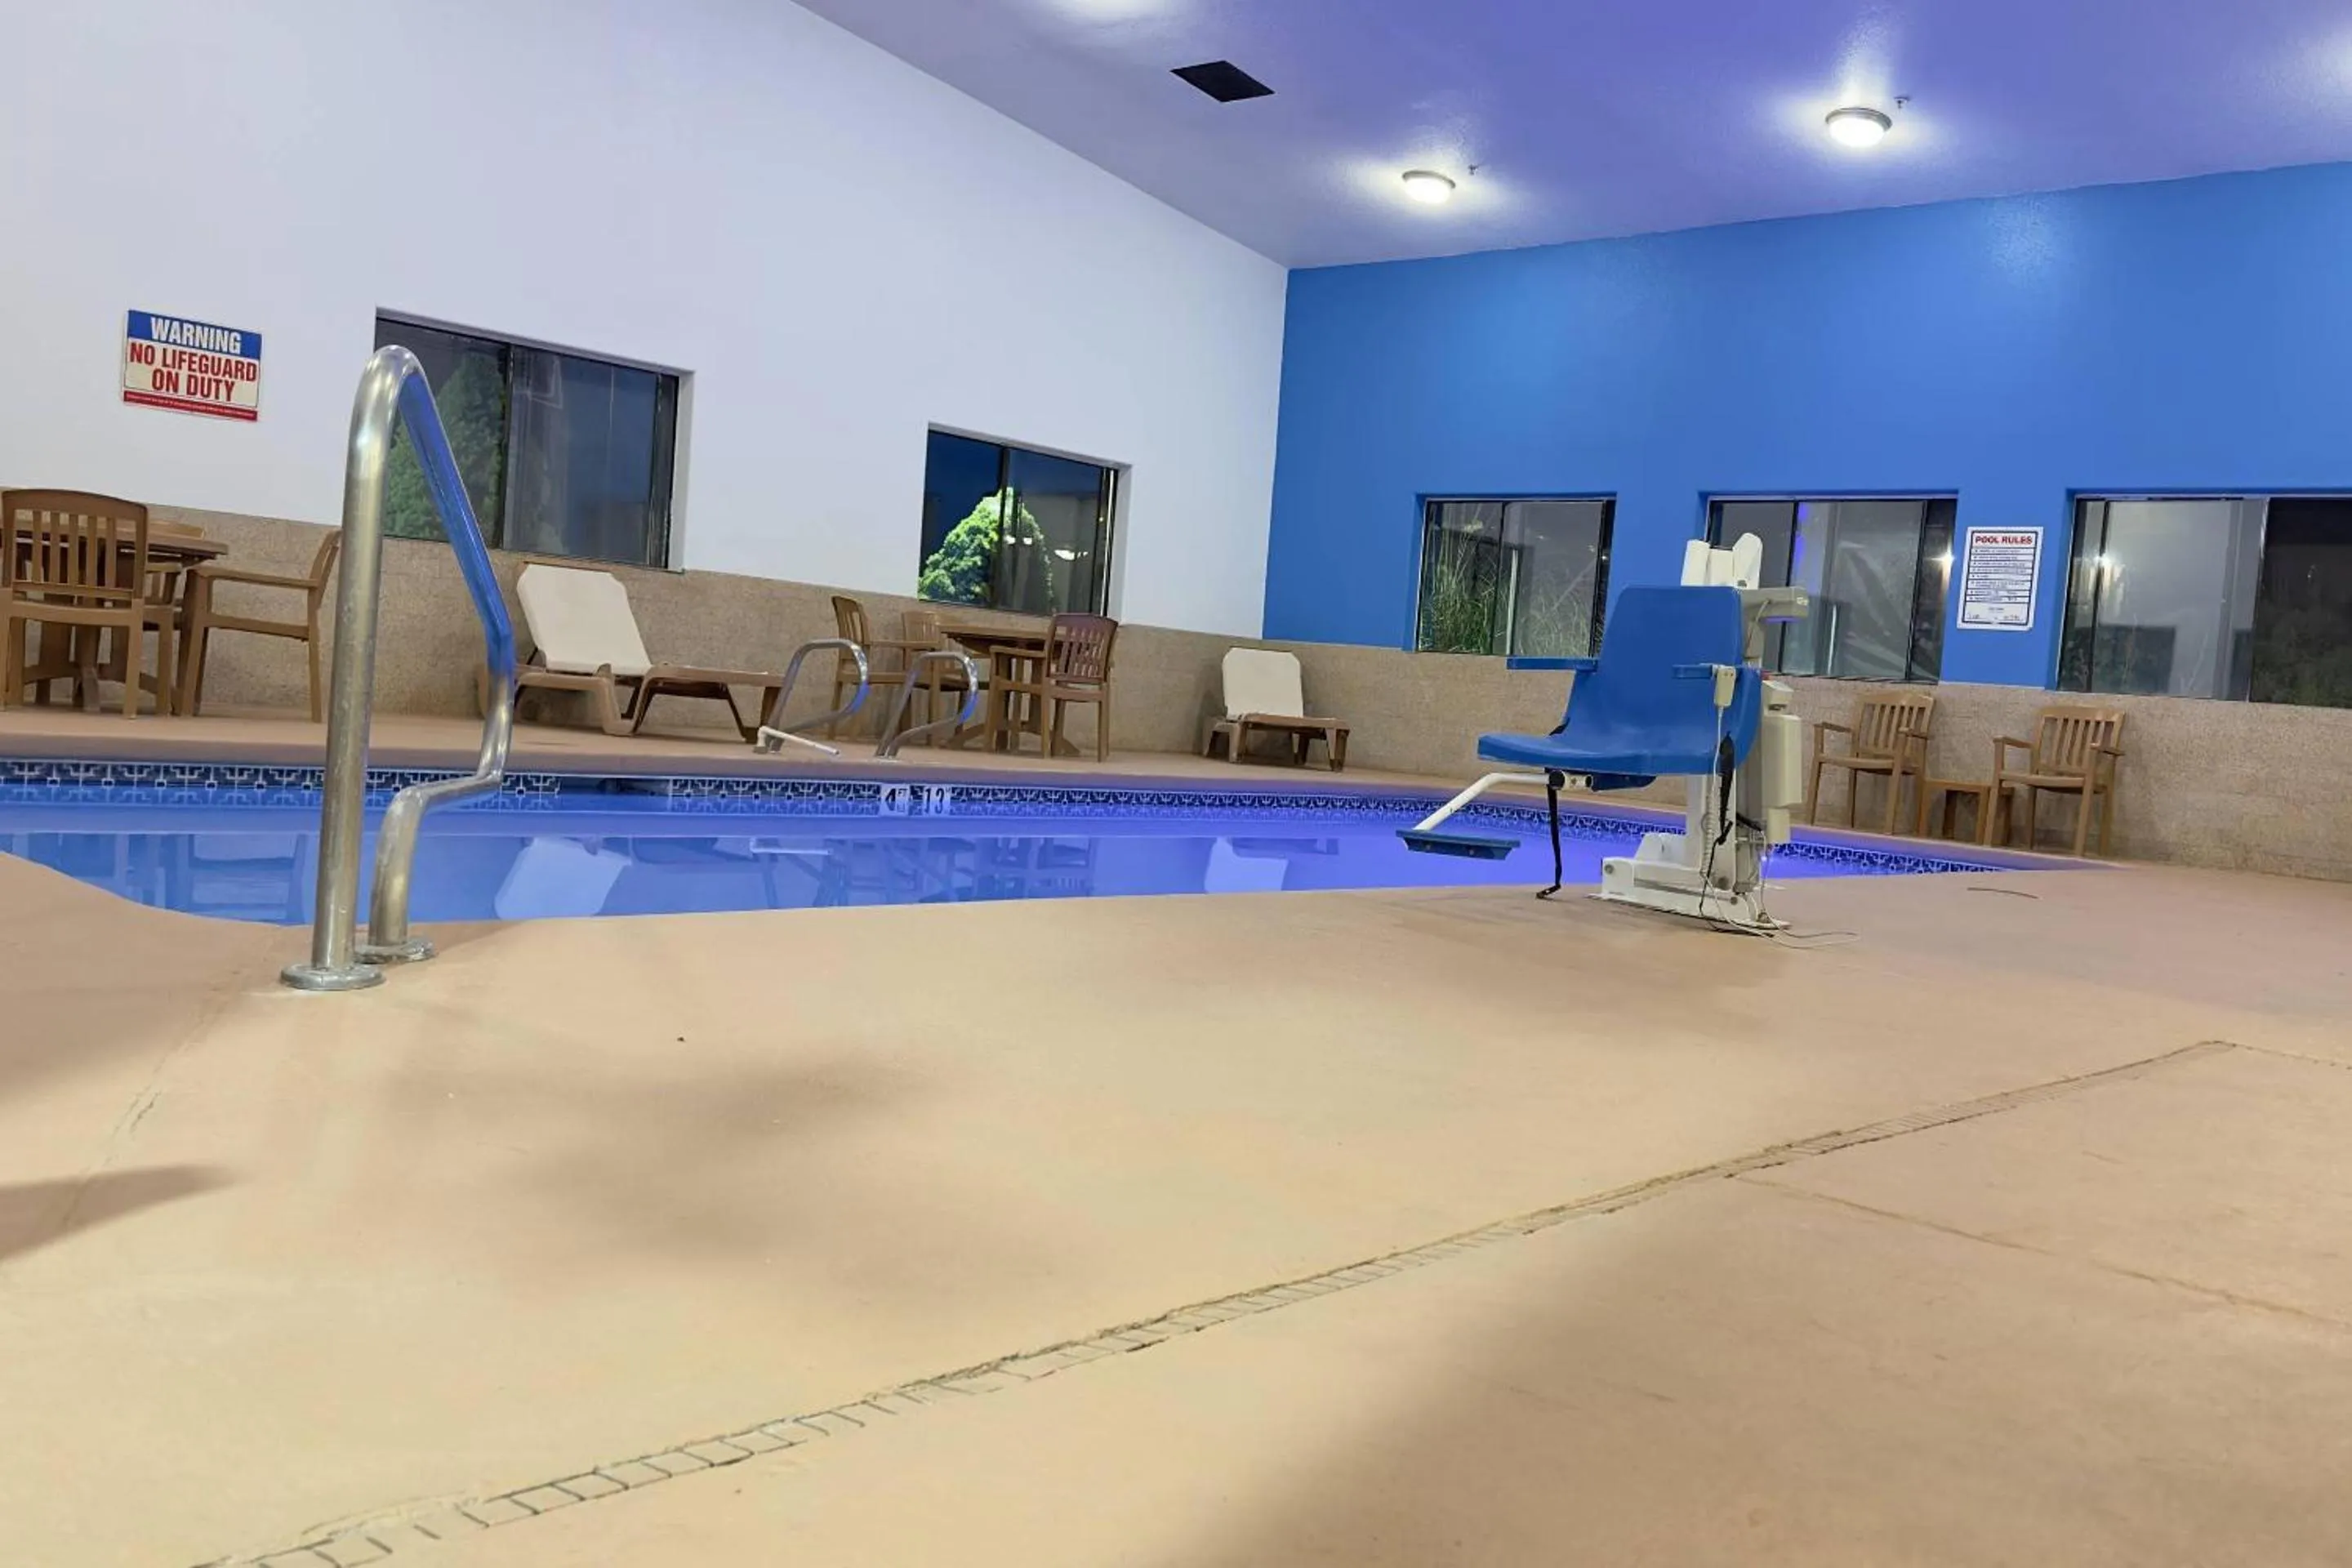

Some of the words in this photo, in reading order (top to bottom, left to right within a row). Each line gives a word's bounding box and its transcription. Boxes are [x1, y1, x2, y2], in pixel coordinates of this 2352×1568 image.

[150, 316, 242, 354] WARNING
[129, 342, 155, 365] NO
[161, 348, 257, 382] LIFEGUARD
[152, 368, 180, 393] ON
[186, 374, 235, 402] DUTY
[1975, 536, 2000, 545] POOL
[2001, 536, 2033, 545] RULES
